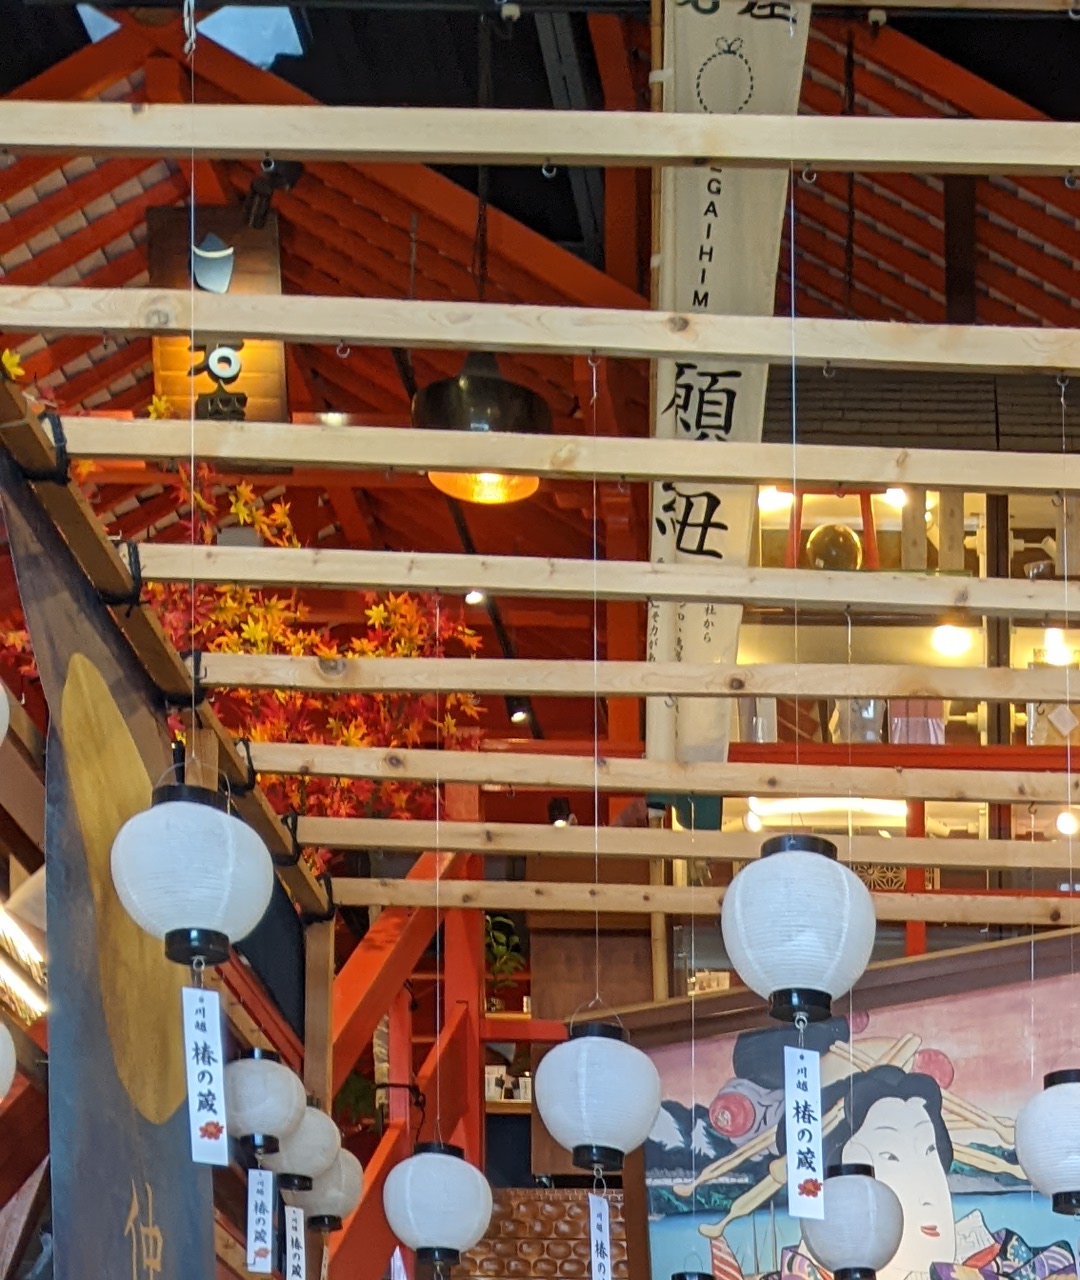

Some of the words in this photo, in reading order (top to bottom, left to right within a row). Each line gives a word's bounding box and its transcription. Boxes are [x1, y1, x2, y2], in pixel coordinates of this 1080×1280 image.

[191, 1040, 219, 1116] 椿の蔵
[792, 1099, 818, 1173] 椿の蔵
